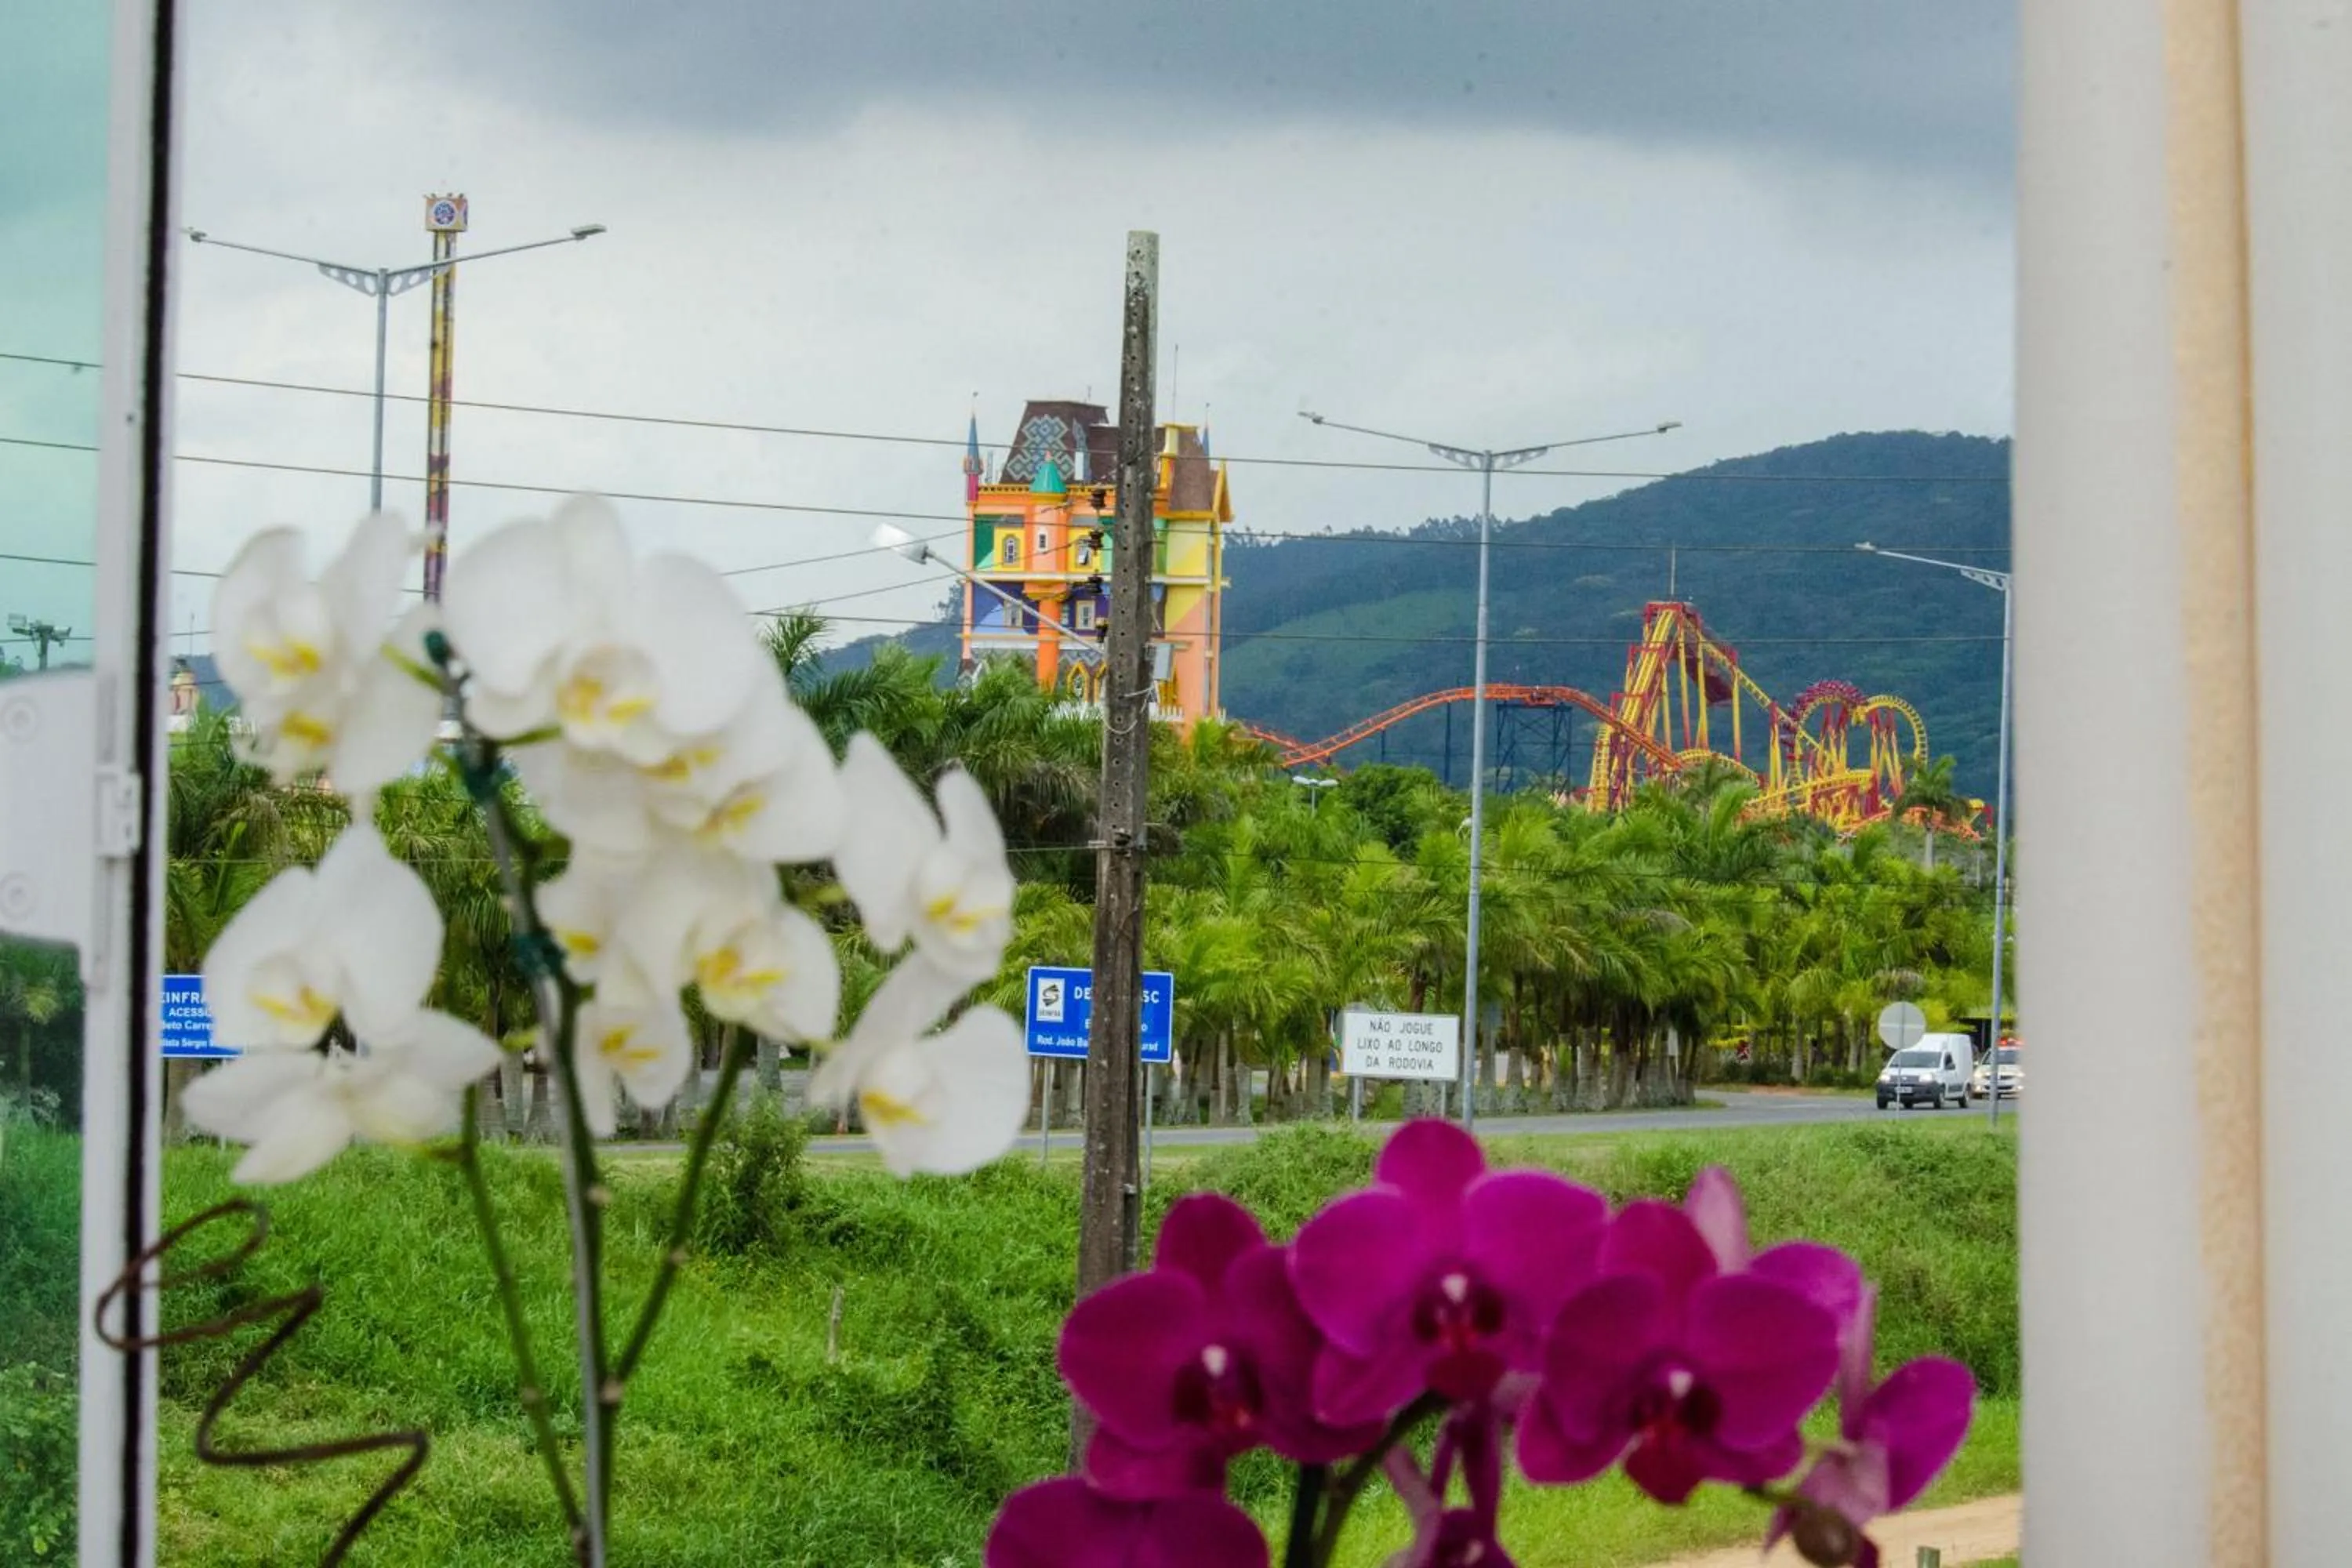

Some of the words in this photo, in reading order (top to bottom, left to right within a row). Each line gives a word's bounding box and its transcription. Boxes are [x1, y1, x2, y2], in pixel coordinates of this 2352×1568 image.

[1073, 985, 1092, 1000] DE
[1142, 990, 1160, 1004] SC
[1370, 1018, 1391, 1033] NÃO
[1399, 1022, 1434, 1036] JOGUE
[1357, 1037, 1381, 1051] LIXO
[1388, 1039, 1403, 1051] AO
[1408, 1040, 1443, 1054] LONGO
[1366, 1055, 1380, 1068] DA
[1388, 1056, 1435, 1071] RODOVIA
